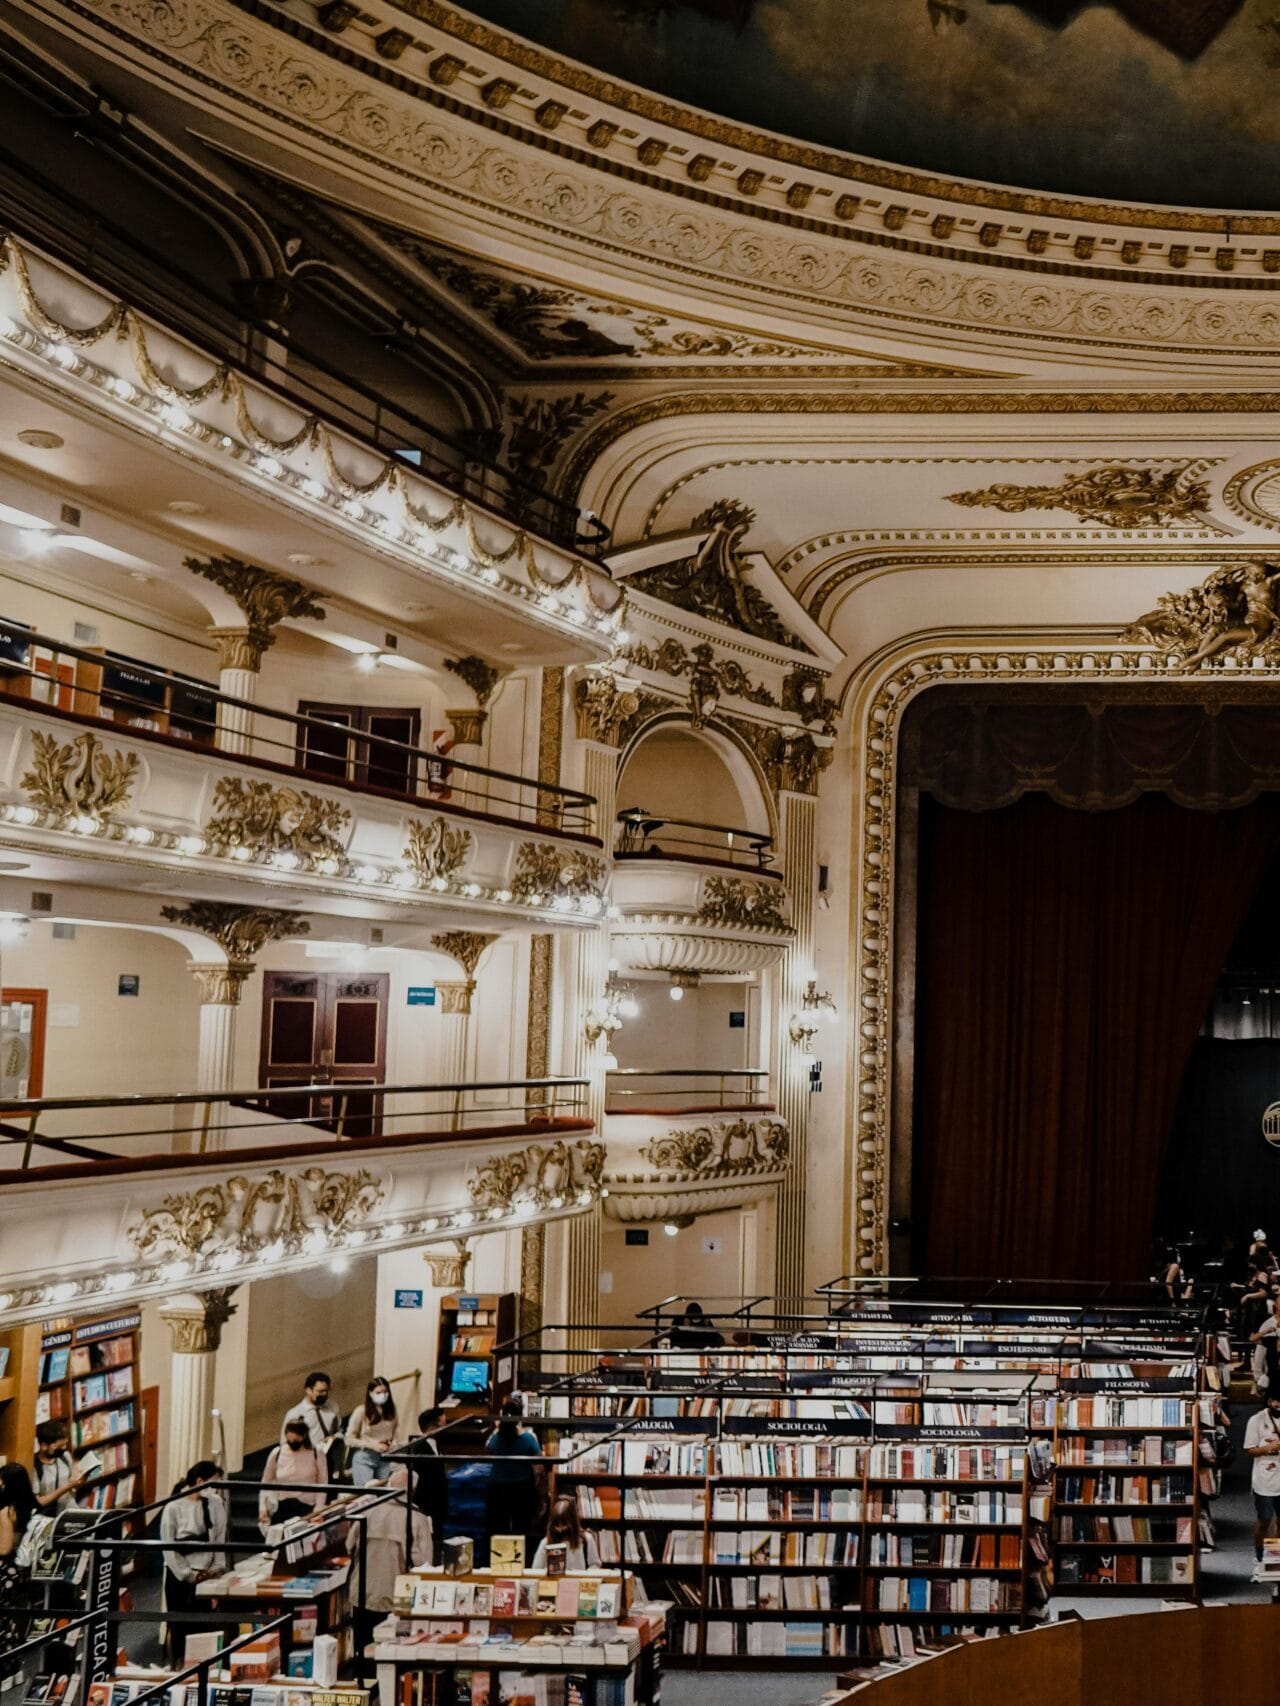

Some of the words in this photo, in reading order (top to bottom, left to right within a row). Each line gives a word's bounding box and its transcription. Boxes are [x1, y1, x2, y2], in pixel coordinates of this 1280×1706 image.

[1104, 1381, 1150, 1389] FILOSOFIA
[767, 1422, 828, 1432] SOCIOLOGIA
[919, 1428, 981, 1437] SOCIOLOGIA
[93, 1561, 113, 1671] BIBLITECA
